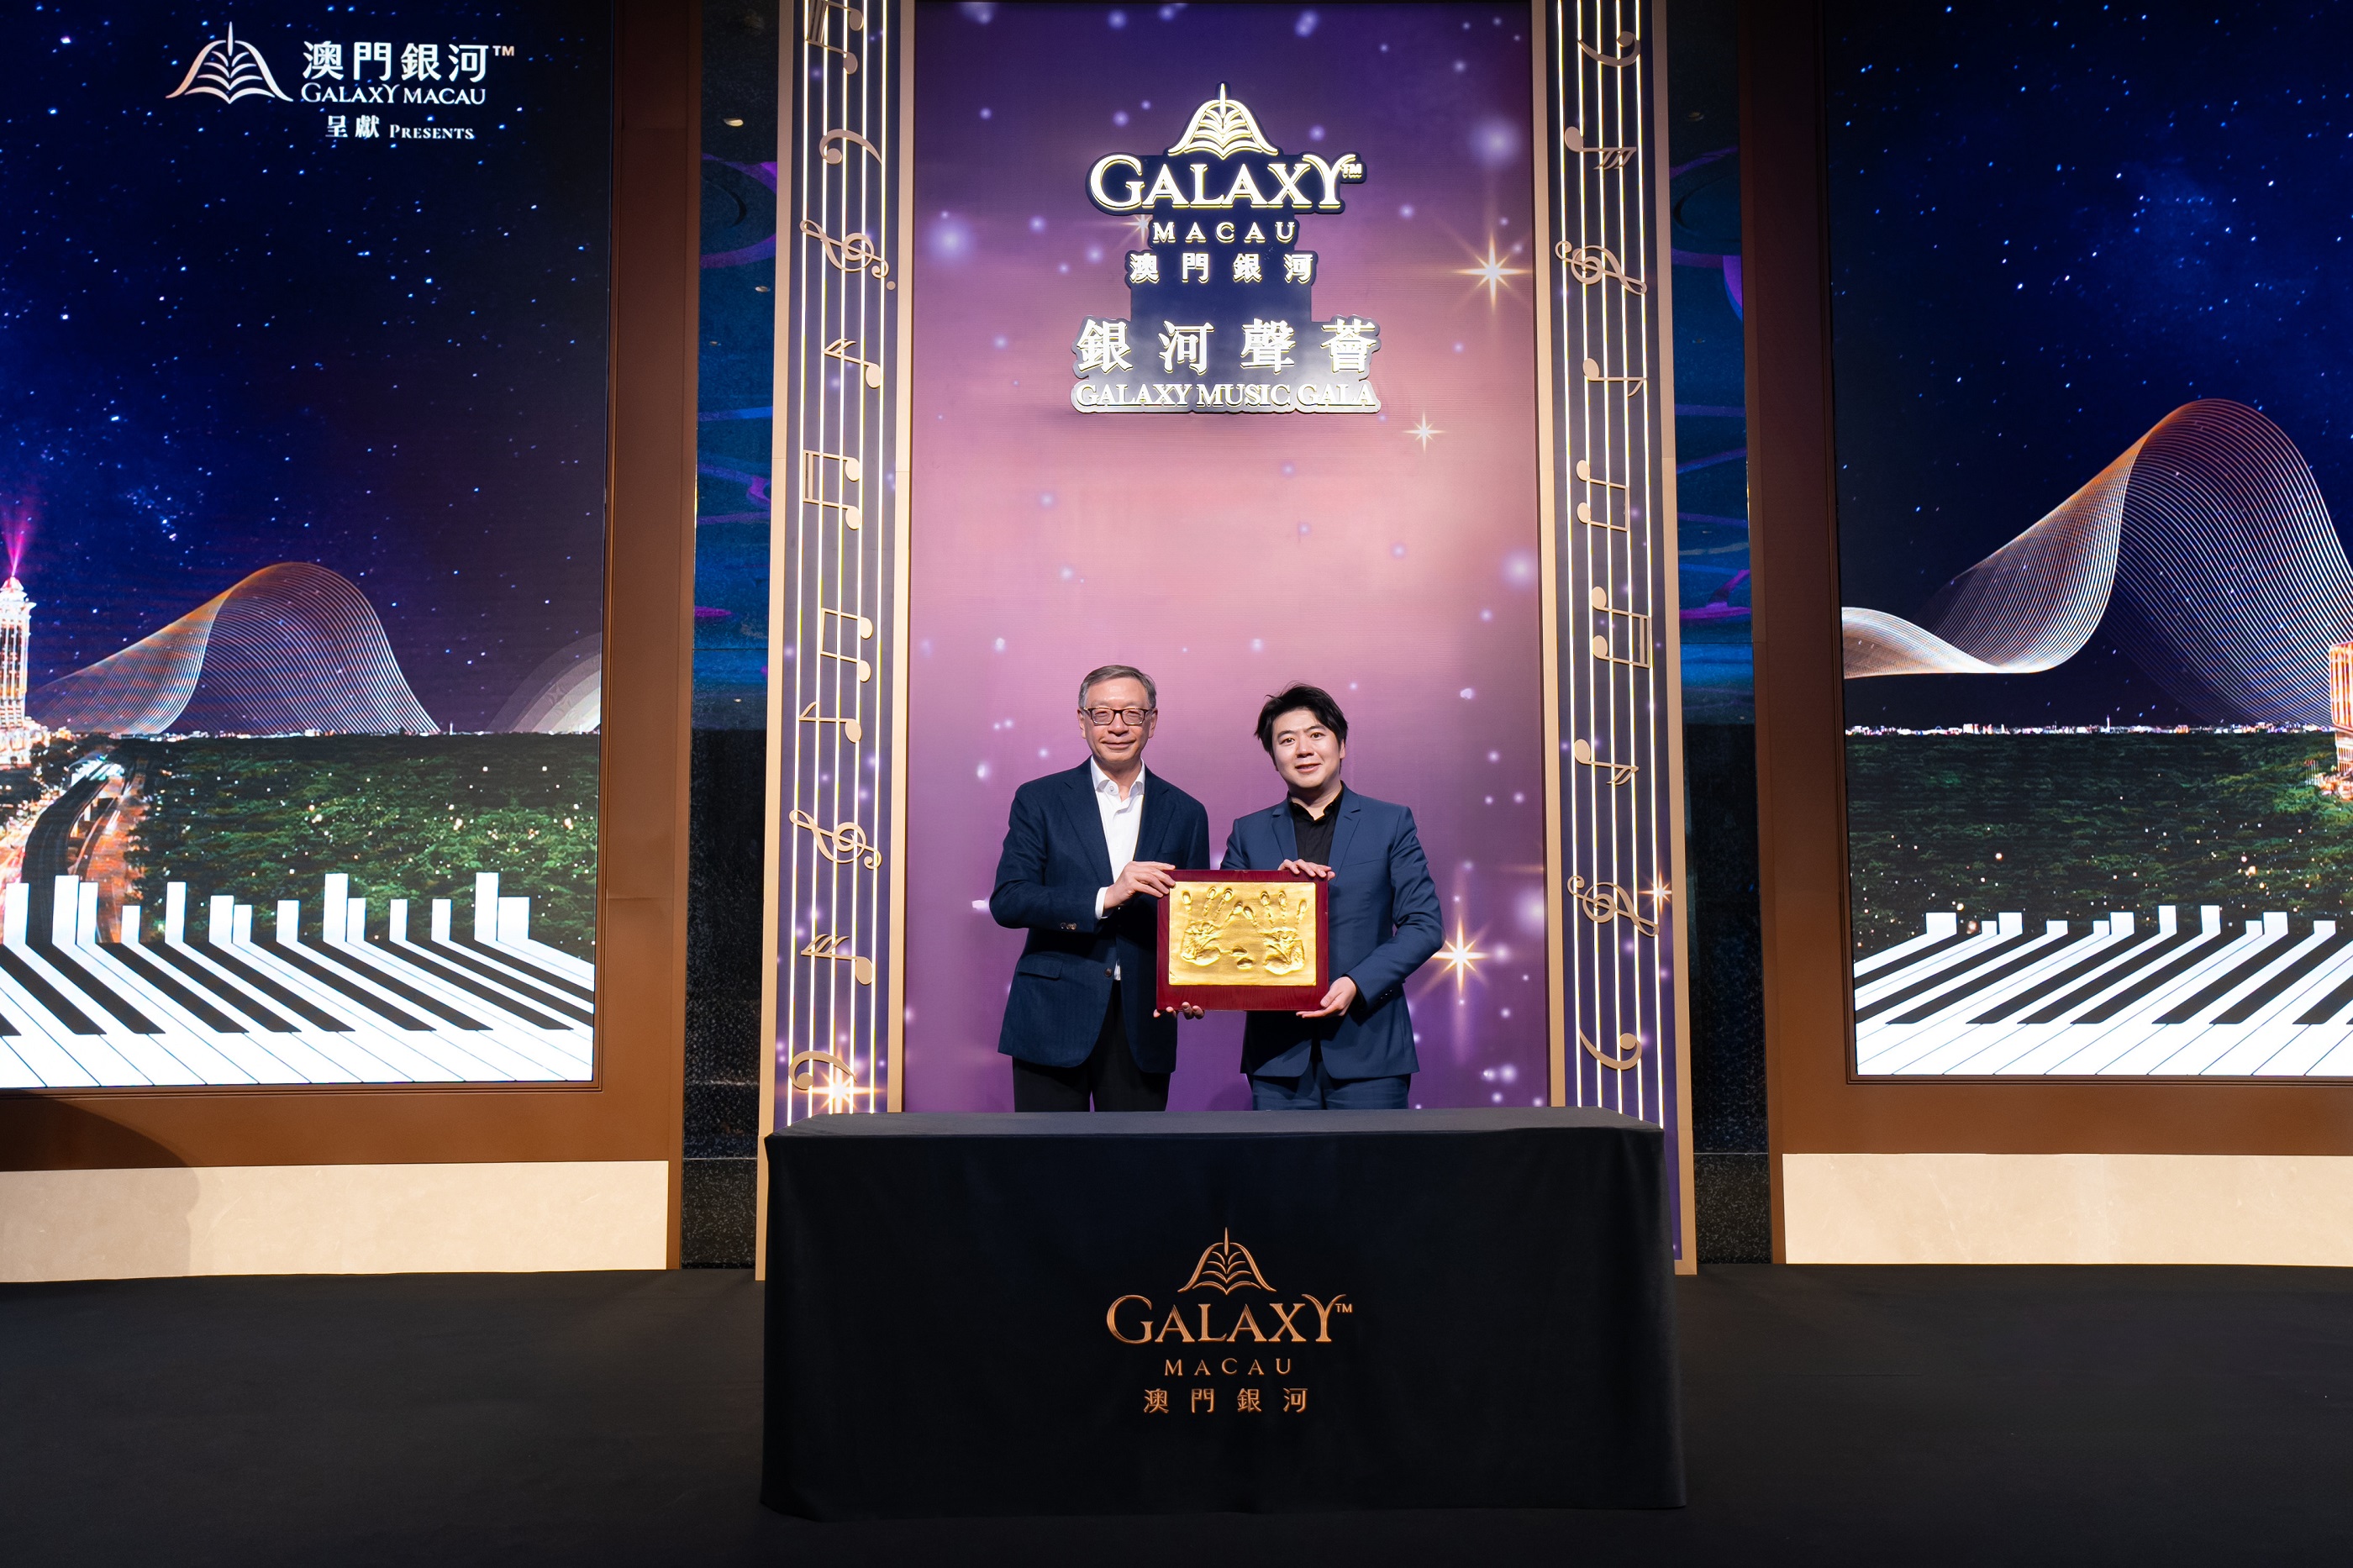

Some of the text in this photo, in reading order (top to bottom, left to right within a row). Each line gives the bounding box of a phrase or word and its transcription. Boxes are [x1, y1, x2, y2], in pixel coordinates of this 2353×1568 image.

[302, 40, 490, 83] 澳門銀河
[300, 82, 487, 106] GALAXY MACAU
[1089, 154, 1356, 210] GALAXY
[1152, 221, 1297, 244] MACAU
[1129, 253, 1314, 284] 澳門銀河
[1075, 318, 1378, 375] 銀河聲薈
[1074, 383, 1377, 408] GALAXY MUSIC GALA
[1106, 1293, 1347, 1344] GALAXY
[1164, 1357, 1292, 1376] MACAU
[1143, 1387, 1308, 1413] 澳門銀河
